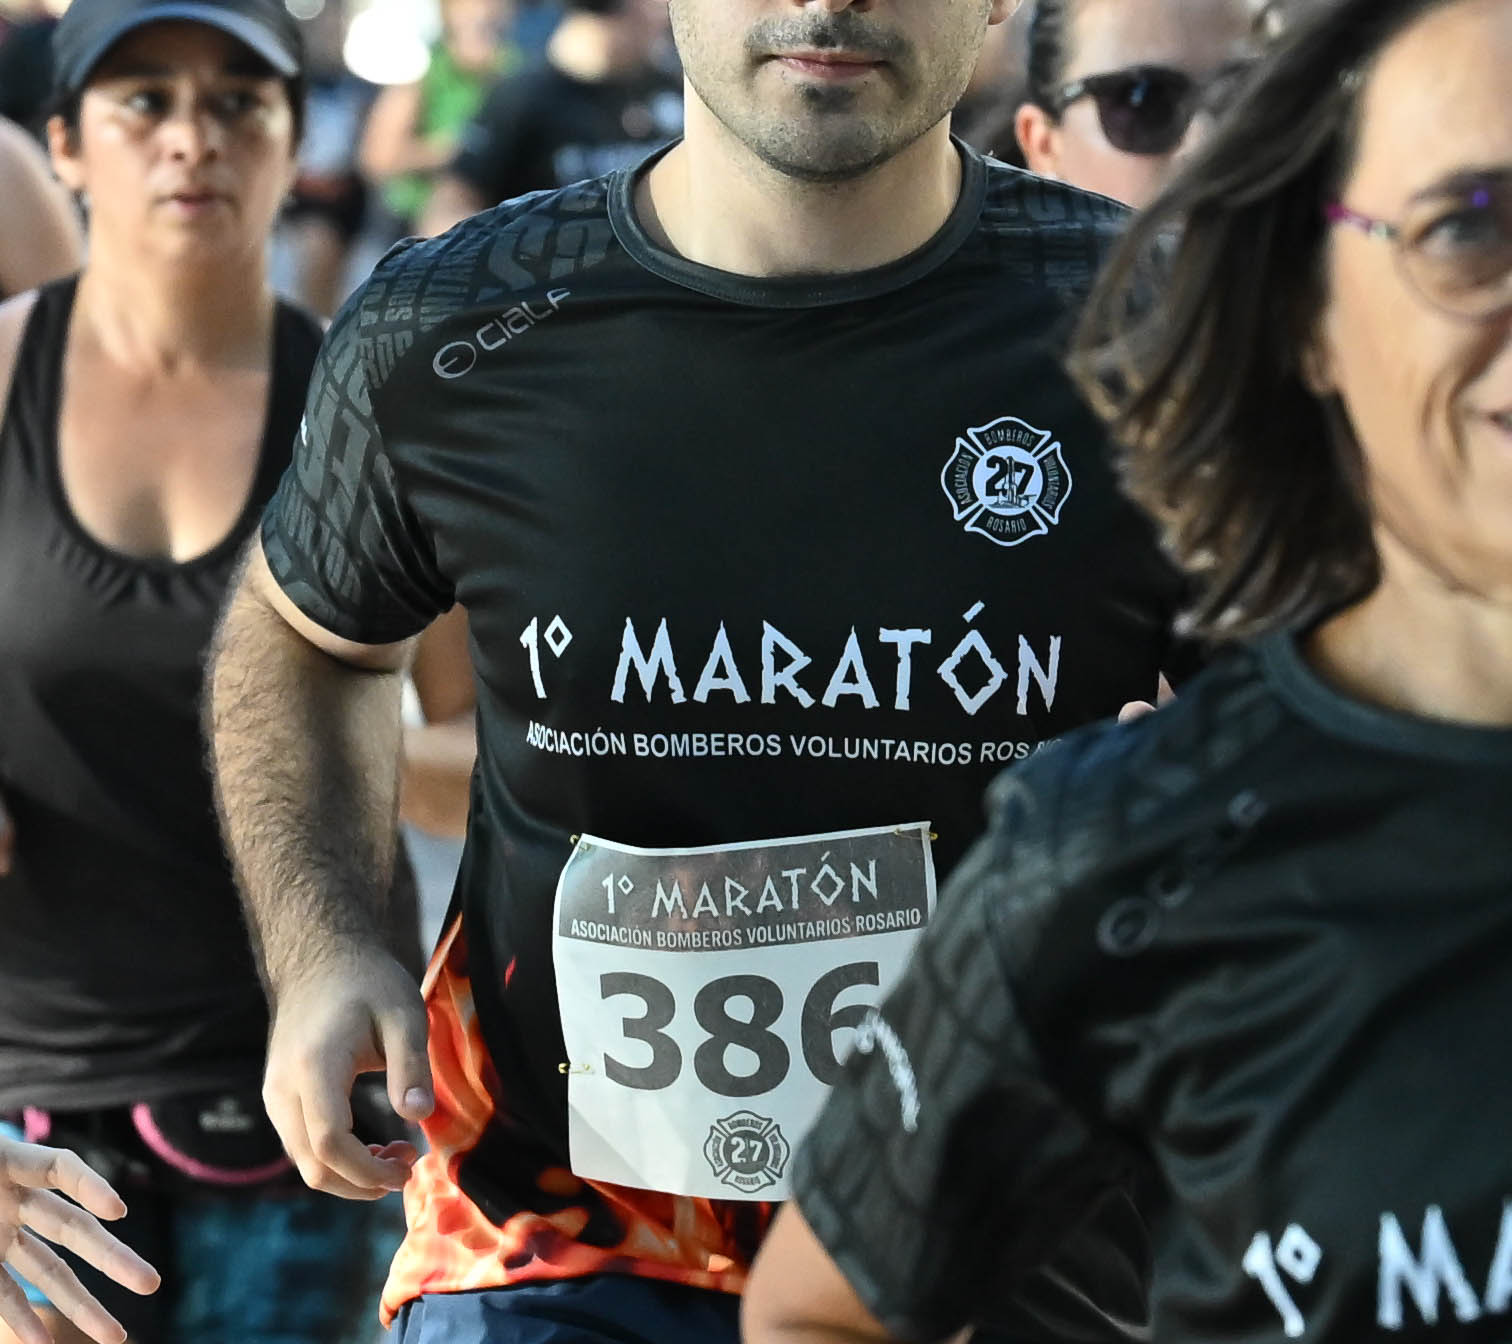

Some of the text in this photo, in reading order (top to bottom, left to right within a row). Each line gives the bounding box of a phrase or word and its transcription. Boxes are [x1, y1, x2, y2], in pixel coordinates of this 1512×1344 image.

[985, 455, 1035, 497] 27
[986, 516, 1028, 533] ROSARIO
[610, 600, 1062, 716] MARATÓN
[525, 720, 627, 757] ASOCIACIÓN
[633, 733, 782, 758] BOMBEROS
[790, 736, 972, 765] VOLUNTARIOS
[651, 851, 879, 920] MARATÓN
[571, 908, 922, 949] ASOCIACIÓN BOMBEROS VOLUNTARIOS ROSARIO
[599, 961, 881, 1098] 386
[730, 1136, 763, 1164] 27
